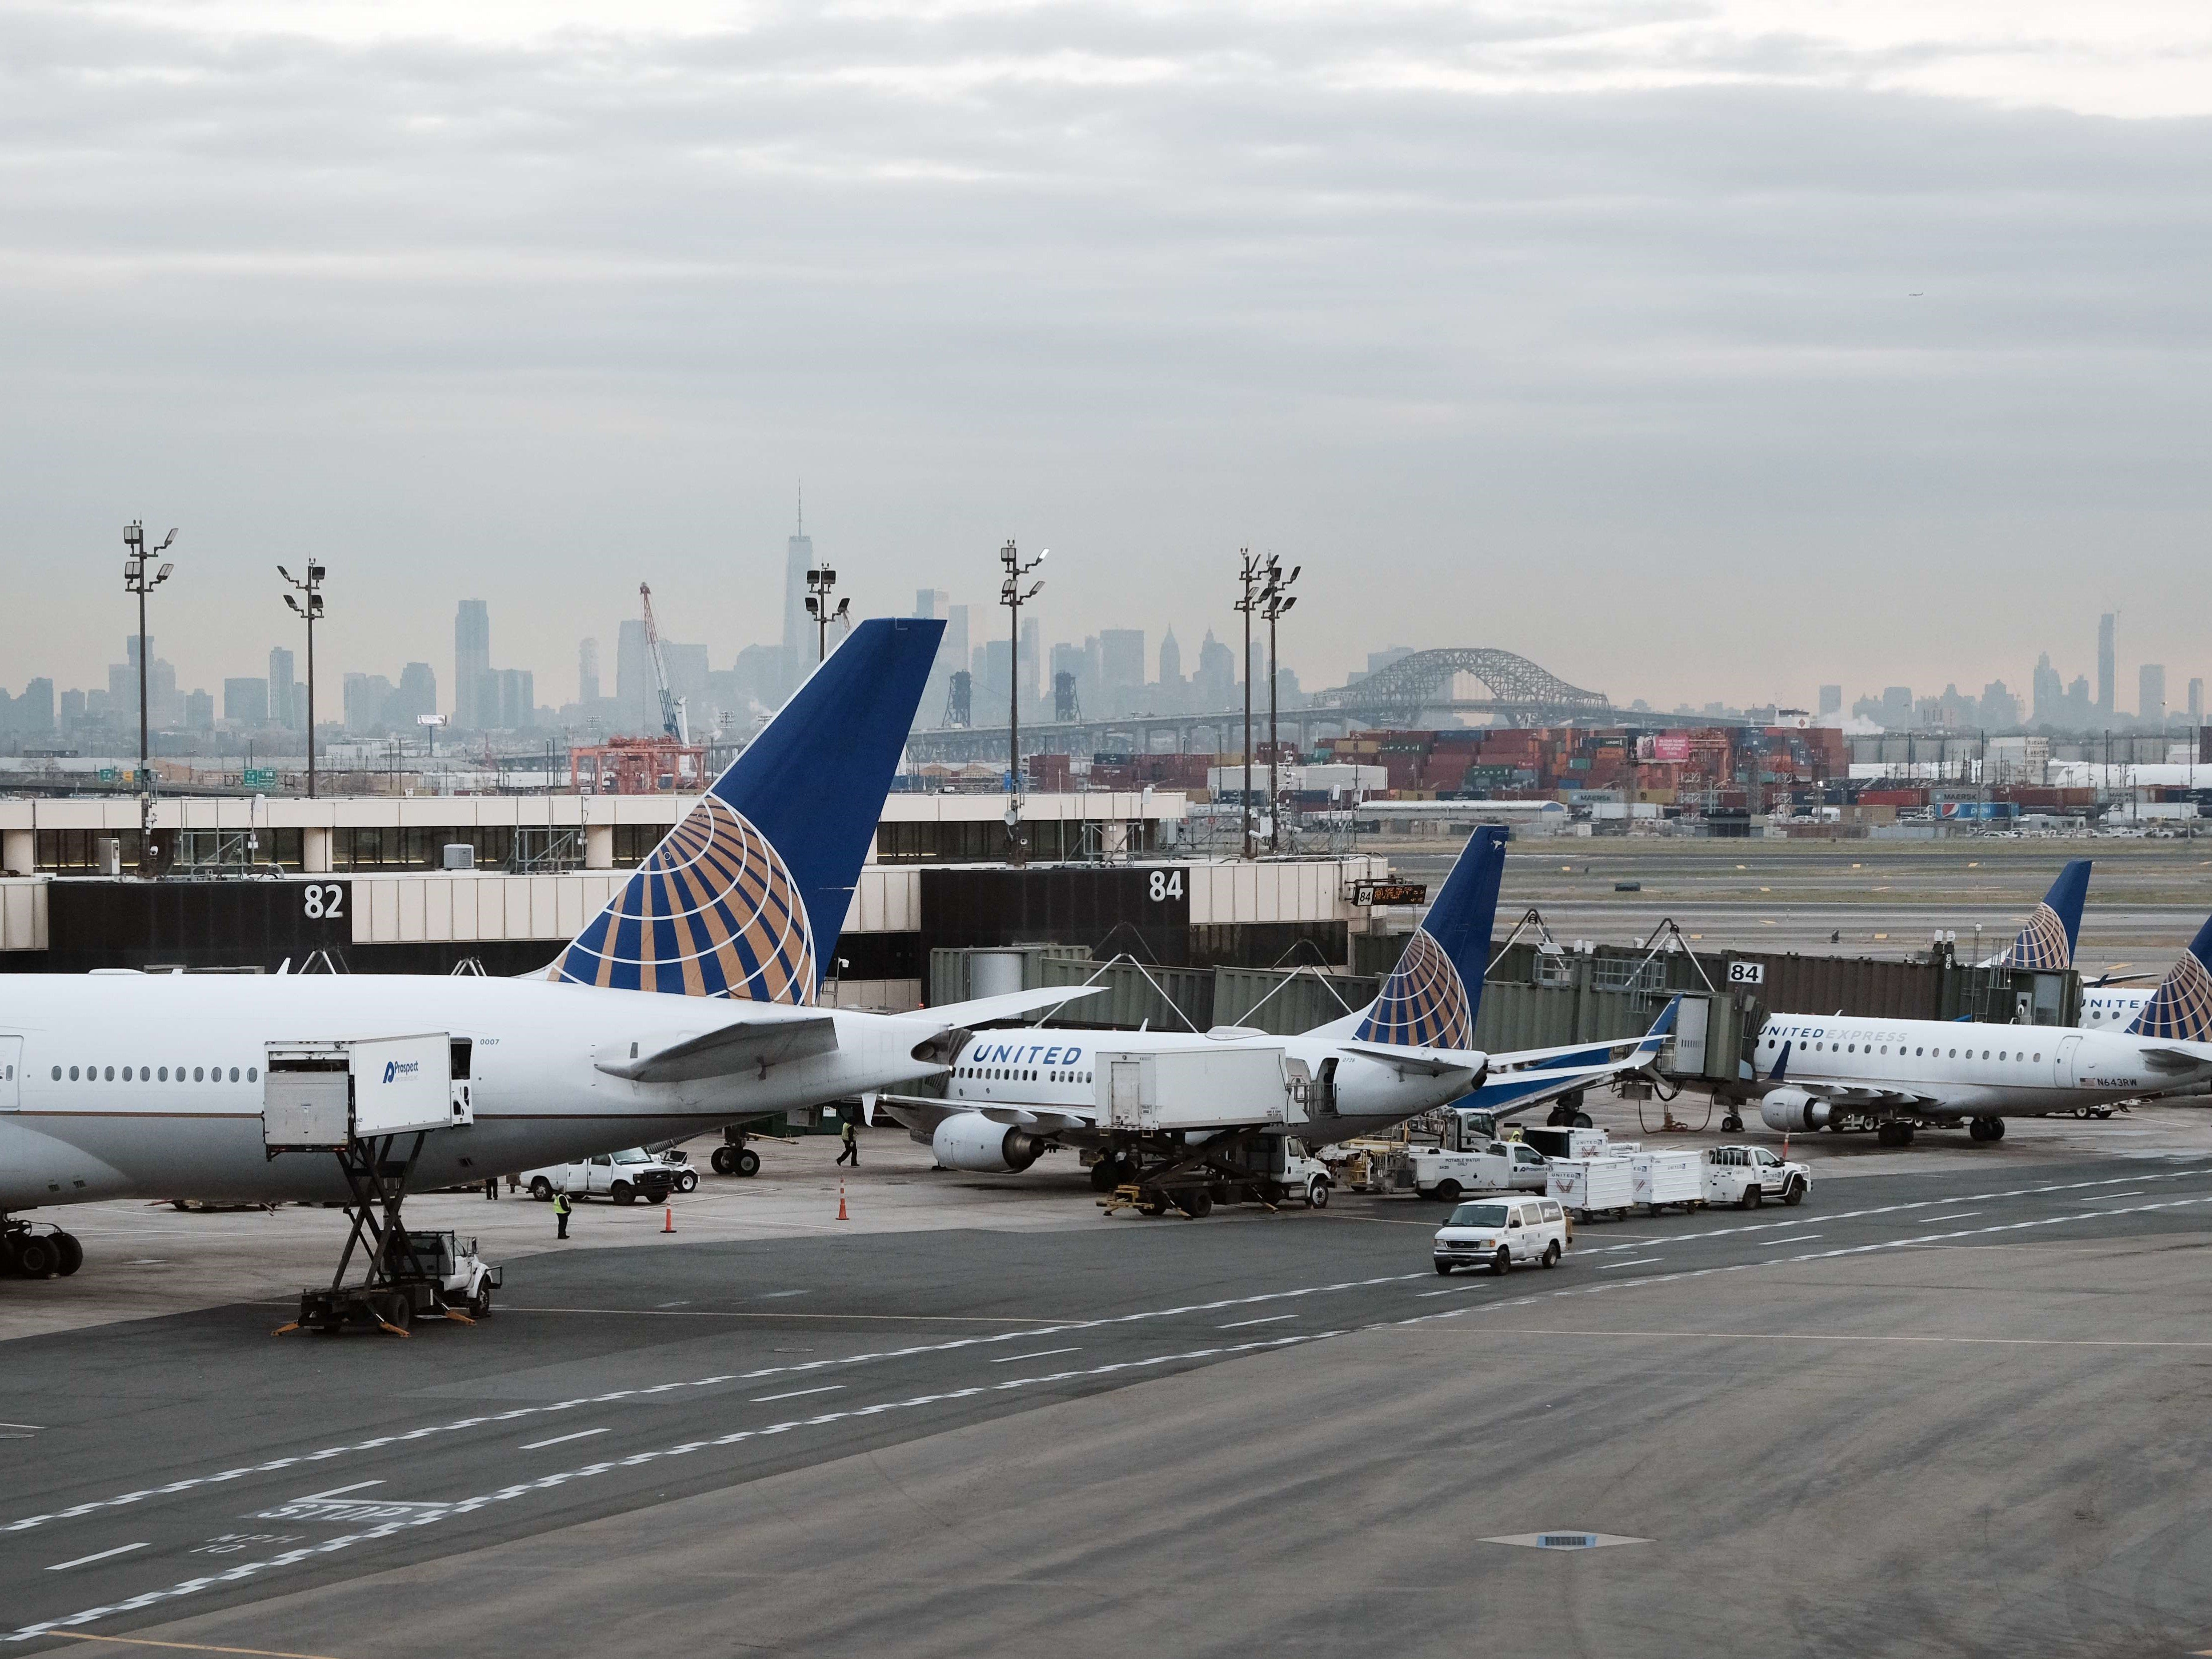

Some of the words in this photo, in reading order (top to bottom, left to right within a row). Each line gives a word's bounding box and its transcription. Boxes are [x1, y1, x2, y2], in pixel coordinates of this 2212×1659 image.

[1150, 871, 1183, 902] 84
[304, 884, 343, 919] 82
[1360, 892, 1371, 902] 84
[1946, 953, 1952, 969] 86
[1731, 965, 1759, 981] 84
[1826, 1029, 1907, 1042] EXPRESS
[973, 1045, 1081, 1065] UNITED
[394, 1060, 418, 1075] Prospect
[2097, 1078, 2137, 1086] N643RW
[257, 1504, 412, 1521] STOP
[206, 1534, 305, 1543] MPH
[190, 1545, 246, 1553] 10
